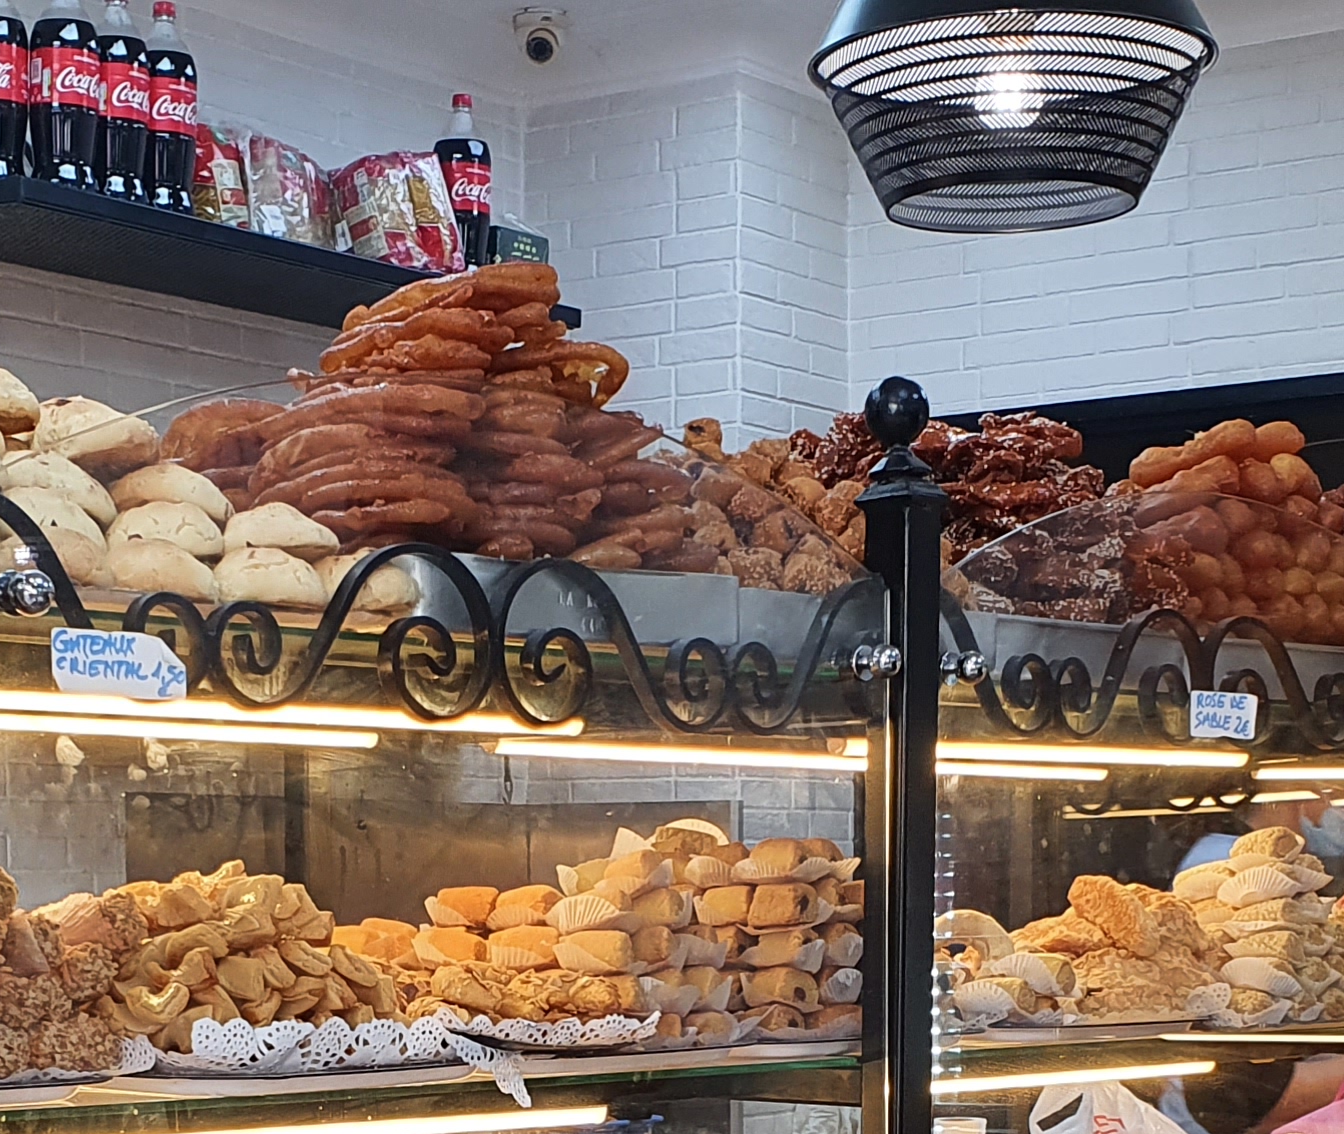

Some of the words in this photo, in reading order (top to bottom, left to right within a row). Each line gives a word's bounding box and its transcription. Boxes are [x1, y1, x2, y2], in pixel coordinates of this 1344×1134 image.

[1196, 692, 1227, 709] ROSE
[1230, 695, 1248, 711] DE
[1194, 710, 1232, 731] SABLE
